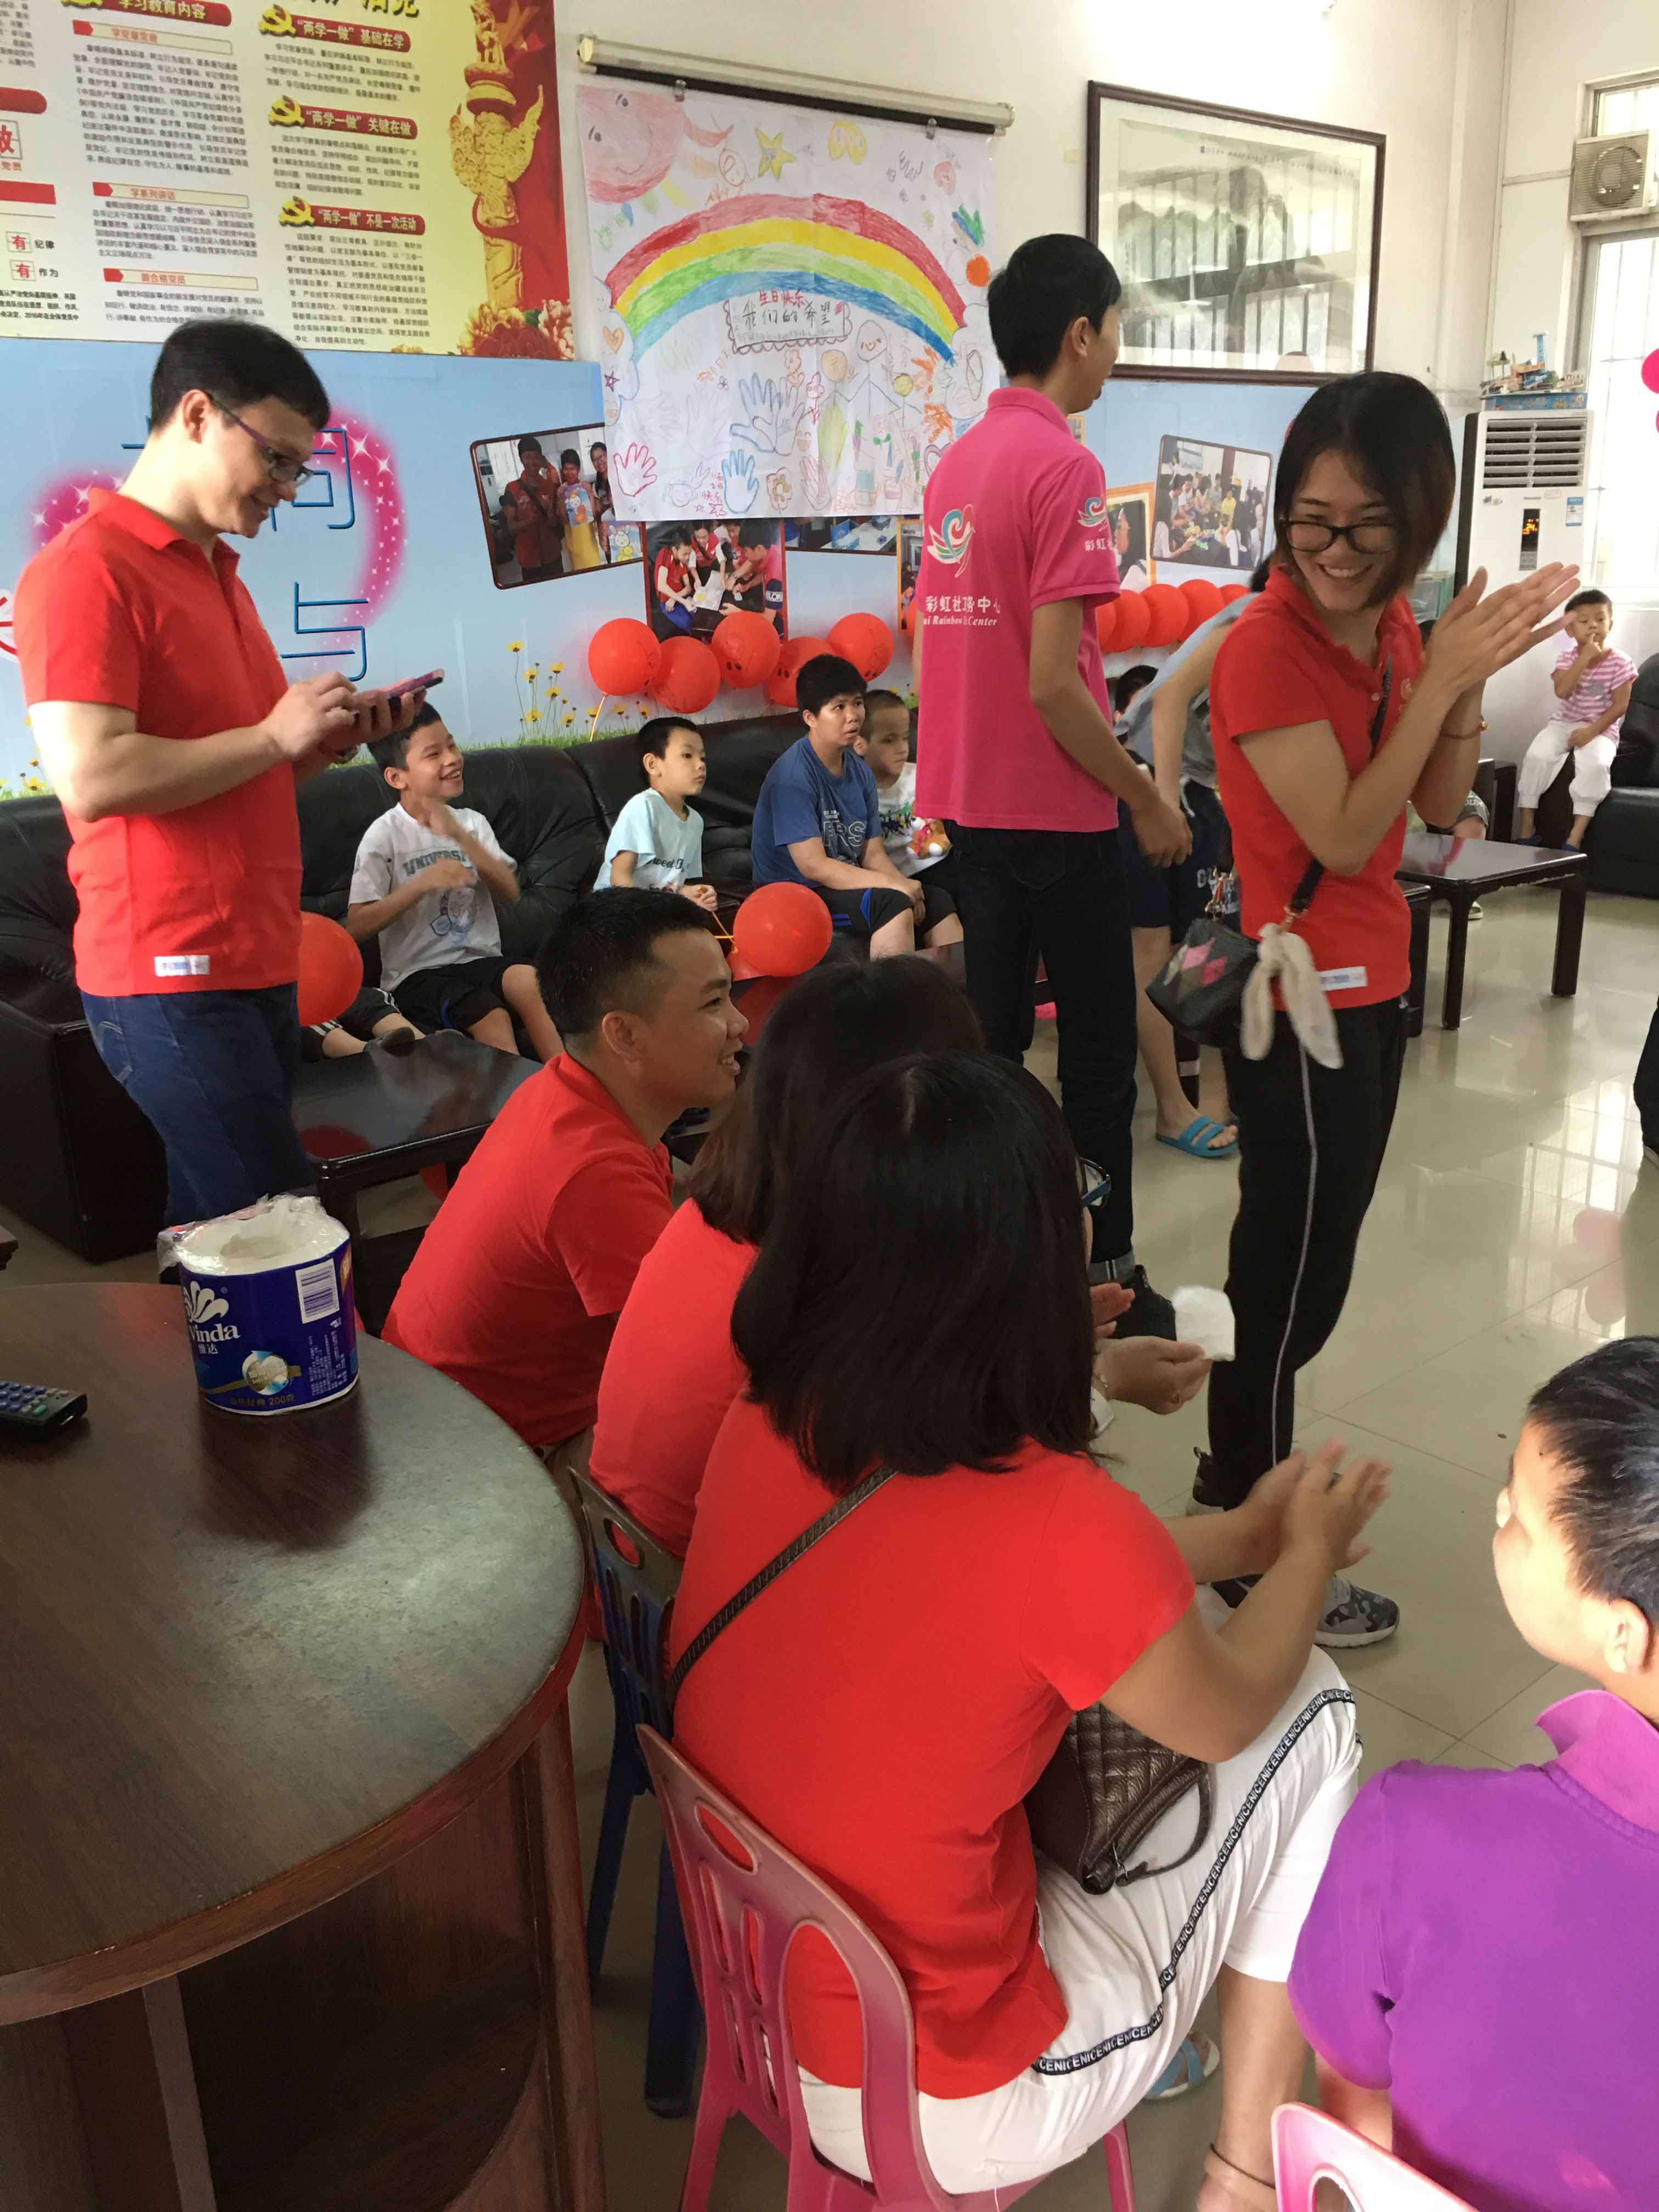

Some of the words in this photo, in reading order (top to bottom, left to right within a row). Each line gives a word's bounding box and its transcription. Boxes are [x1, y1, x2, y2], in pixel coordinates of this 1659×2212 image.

[366, 213, 417, 231] 不是一次活动
[12, 235, 26, 251] 有
[15, 263, 30, 279] 有
[38, 267, 59, 278] 作为
[968, 616, 998, 627] Center
